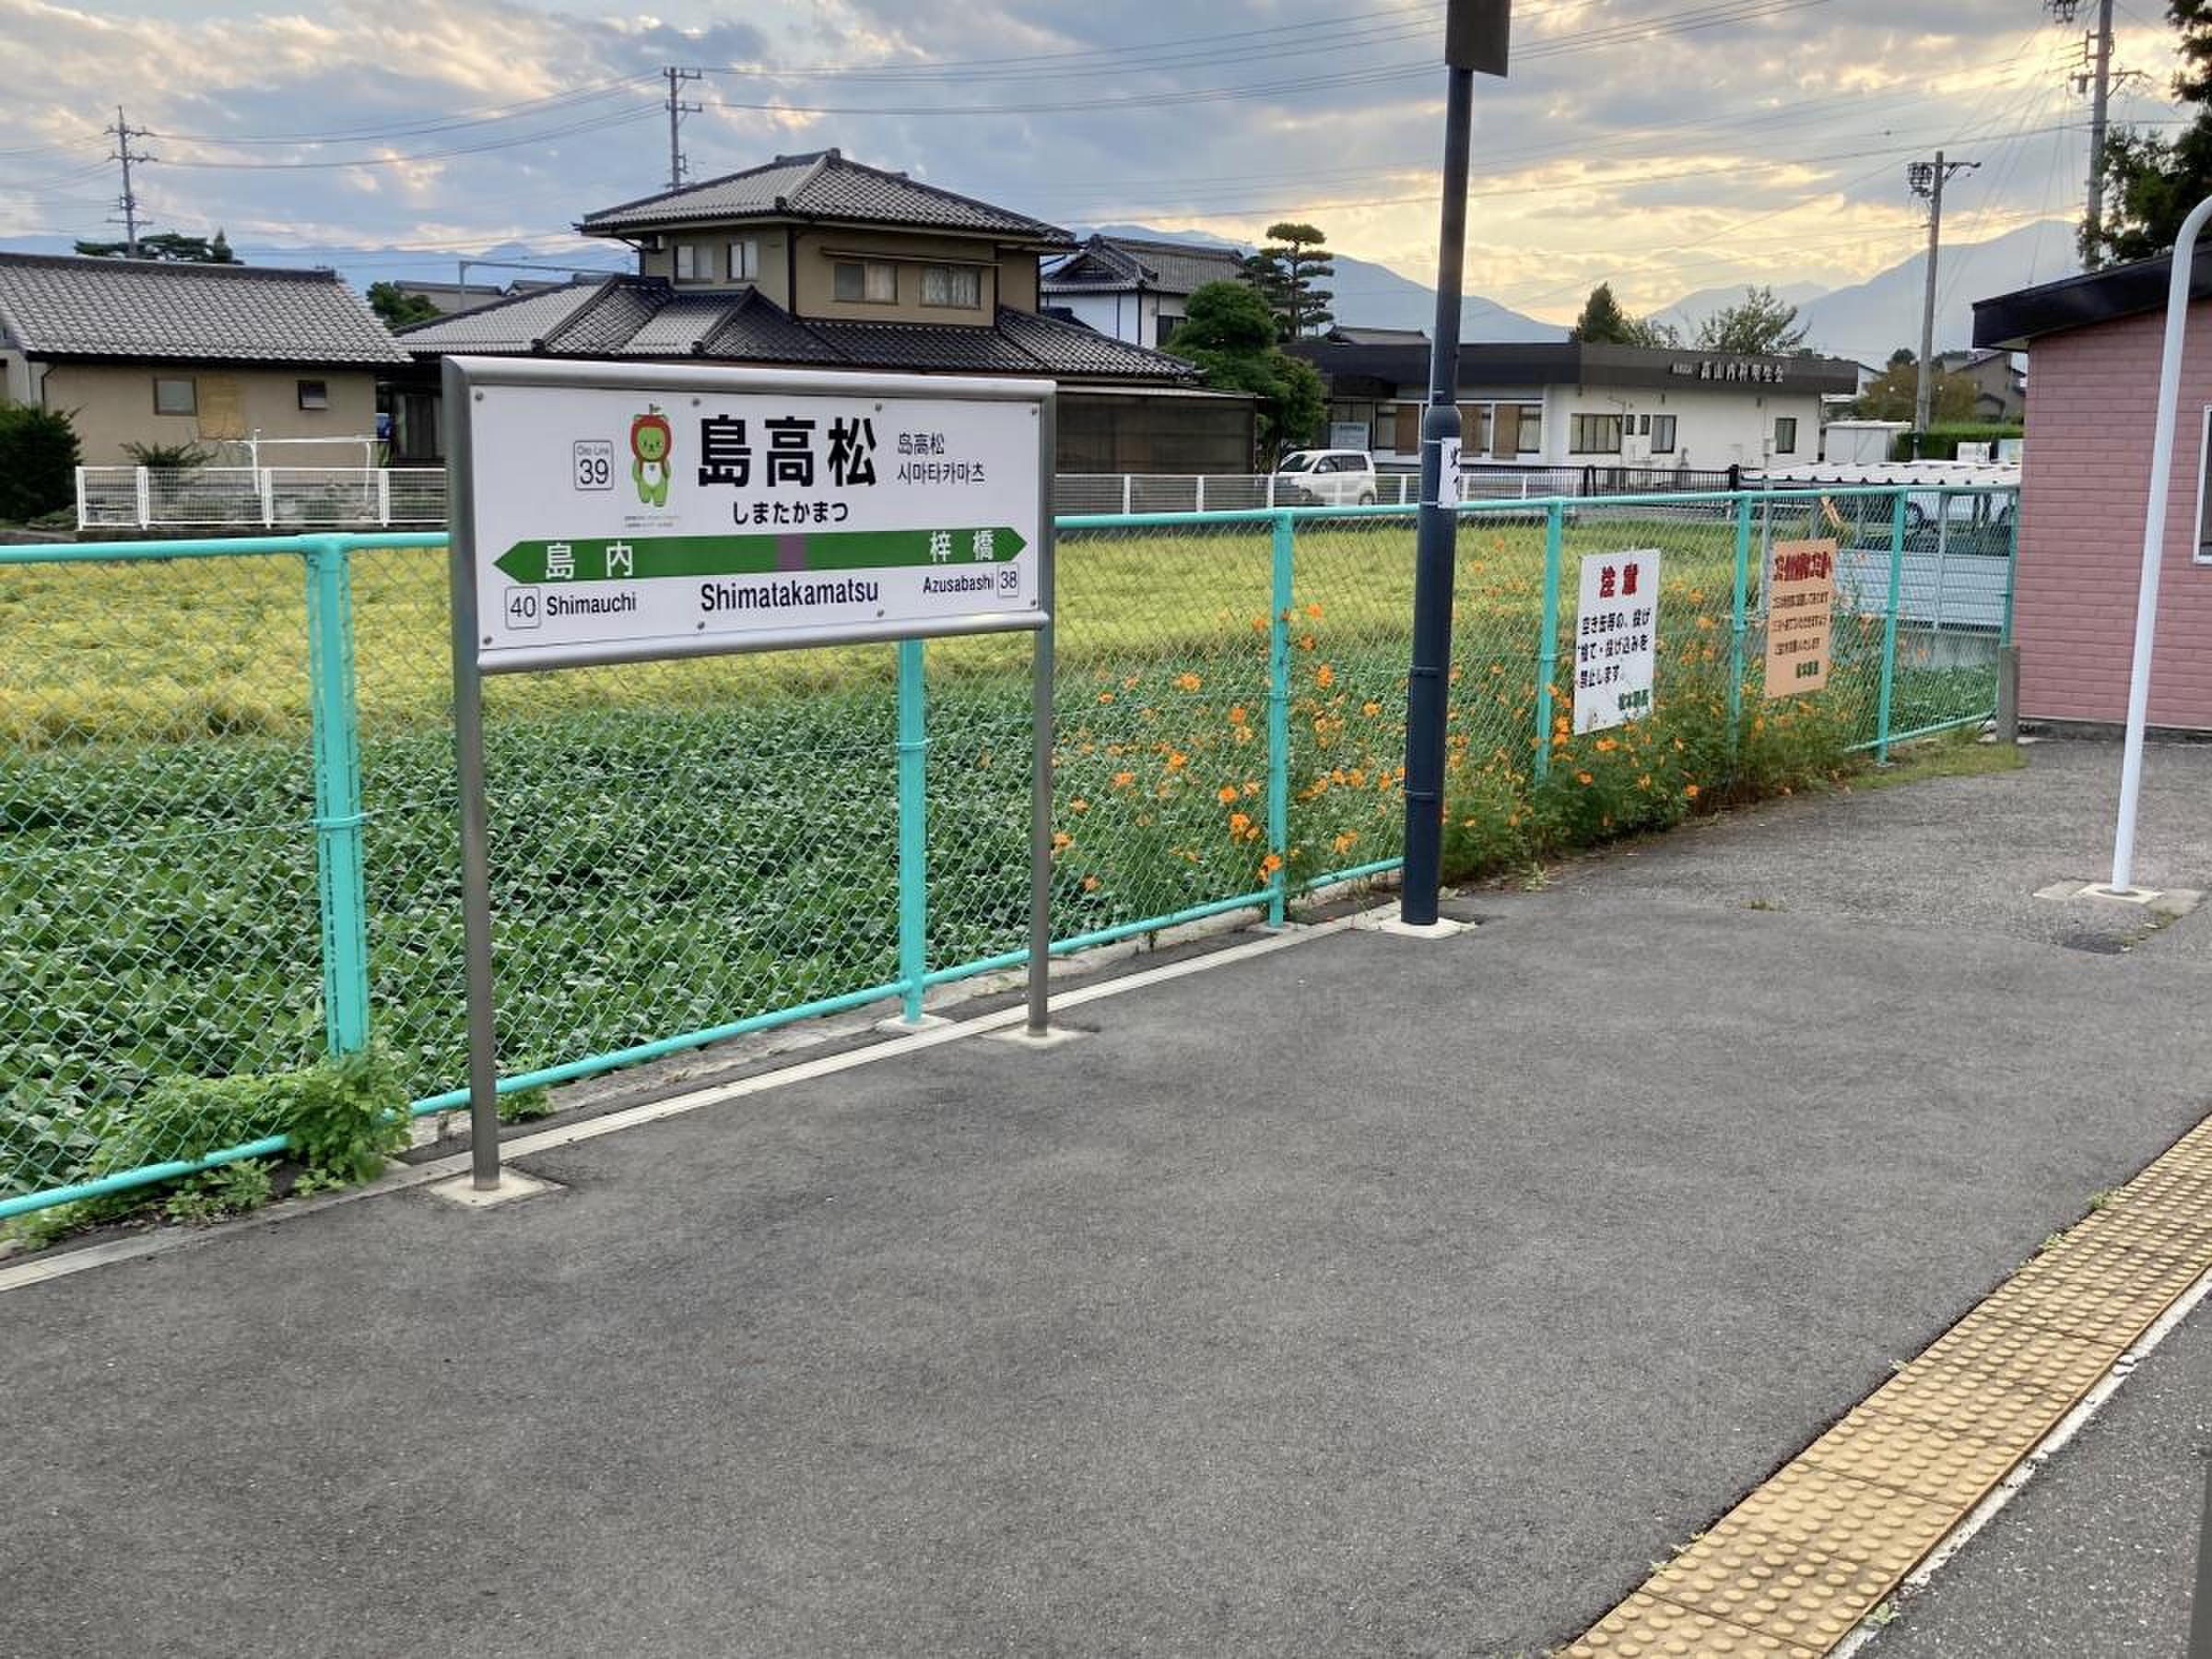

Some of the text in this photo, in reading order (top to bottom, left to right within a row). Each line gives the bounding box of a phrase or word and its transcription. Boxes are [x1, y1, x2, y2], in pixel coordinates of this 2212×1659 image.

[698, 414, 877, 487] 島高松
[580, 458, 608, 485] 39
[897, 462, 985, 485] 시마타카마츠
[733, 501, 848, 524] しまたかまつ
[930, 530, 994, 562] 梓橋
[546, 540, 634, 580] 島内
[923, 573, 994, 594] Azusabashi
[1000, 571, 1018, 590] 38
[510, 595, 535, 618] 40
[546, 592, 636, 616] Shimauchi
[700, 579, 878, 612] Shimatakamatsu
